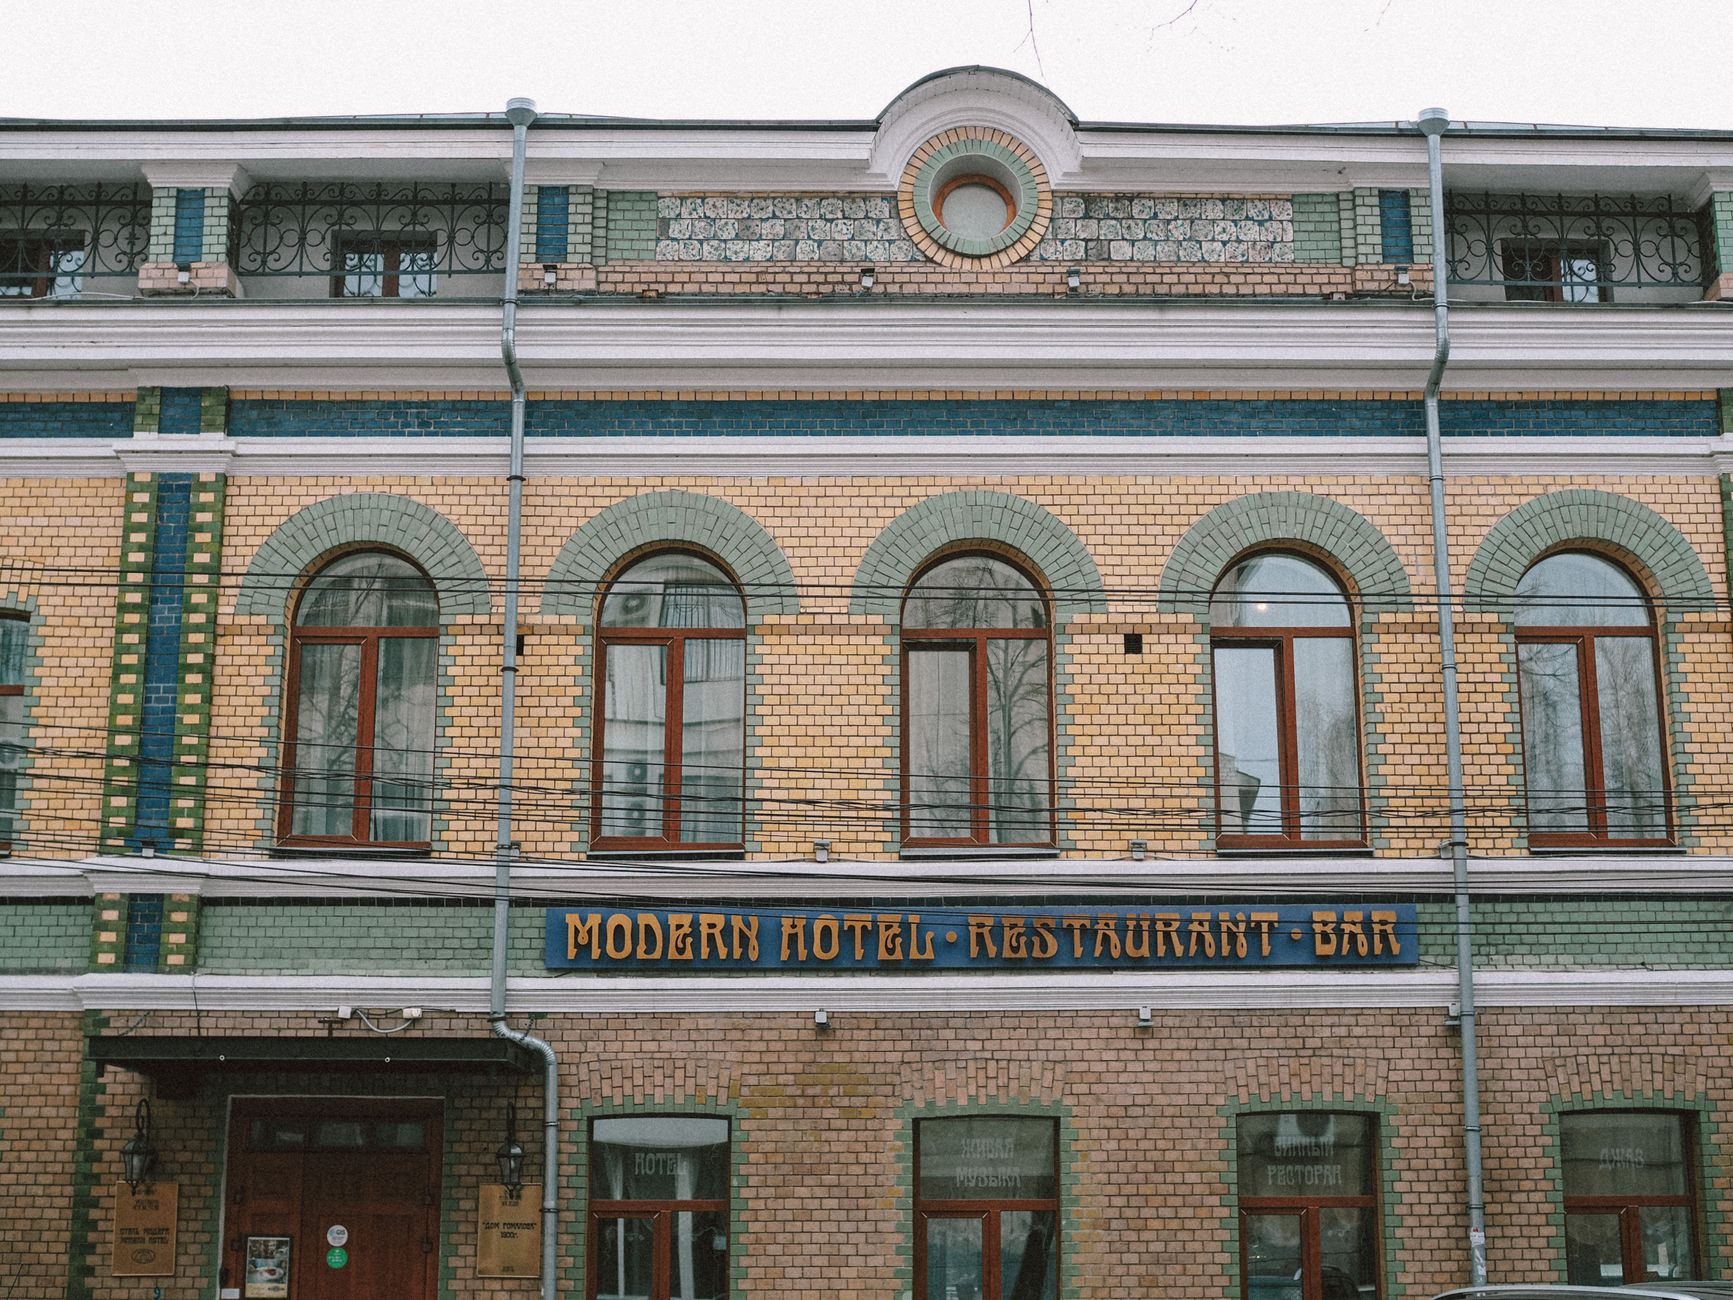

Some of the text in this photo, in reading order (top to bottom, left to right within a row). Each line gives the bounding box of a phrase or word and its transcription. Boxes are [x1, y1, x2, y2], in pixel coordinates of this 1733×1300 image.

[565, 909, 1401, 962] MODERN HOTEL RESTAURANT BAR
[960, 1138, 1016, 1159] ЖИВАЯ
[634, 1152, 688, 1175] HOTEL
[955, 1166, 1021, 1188] МУЗЫКА
[1266, 1164, 1342, 1186] РЕСТОРАН
